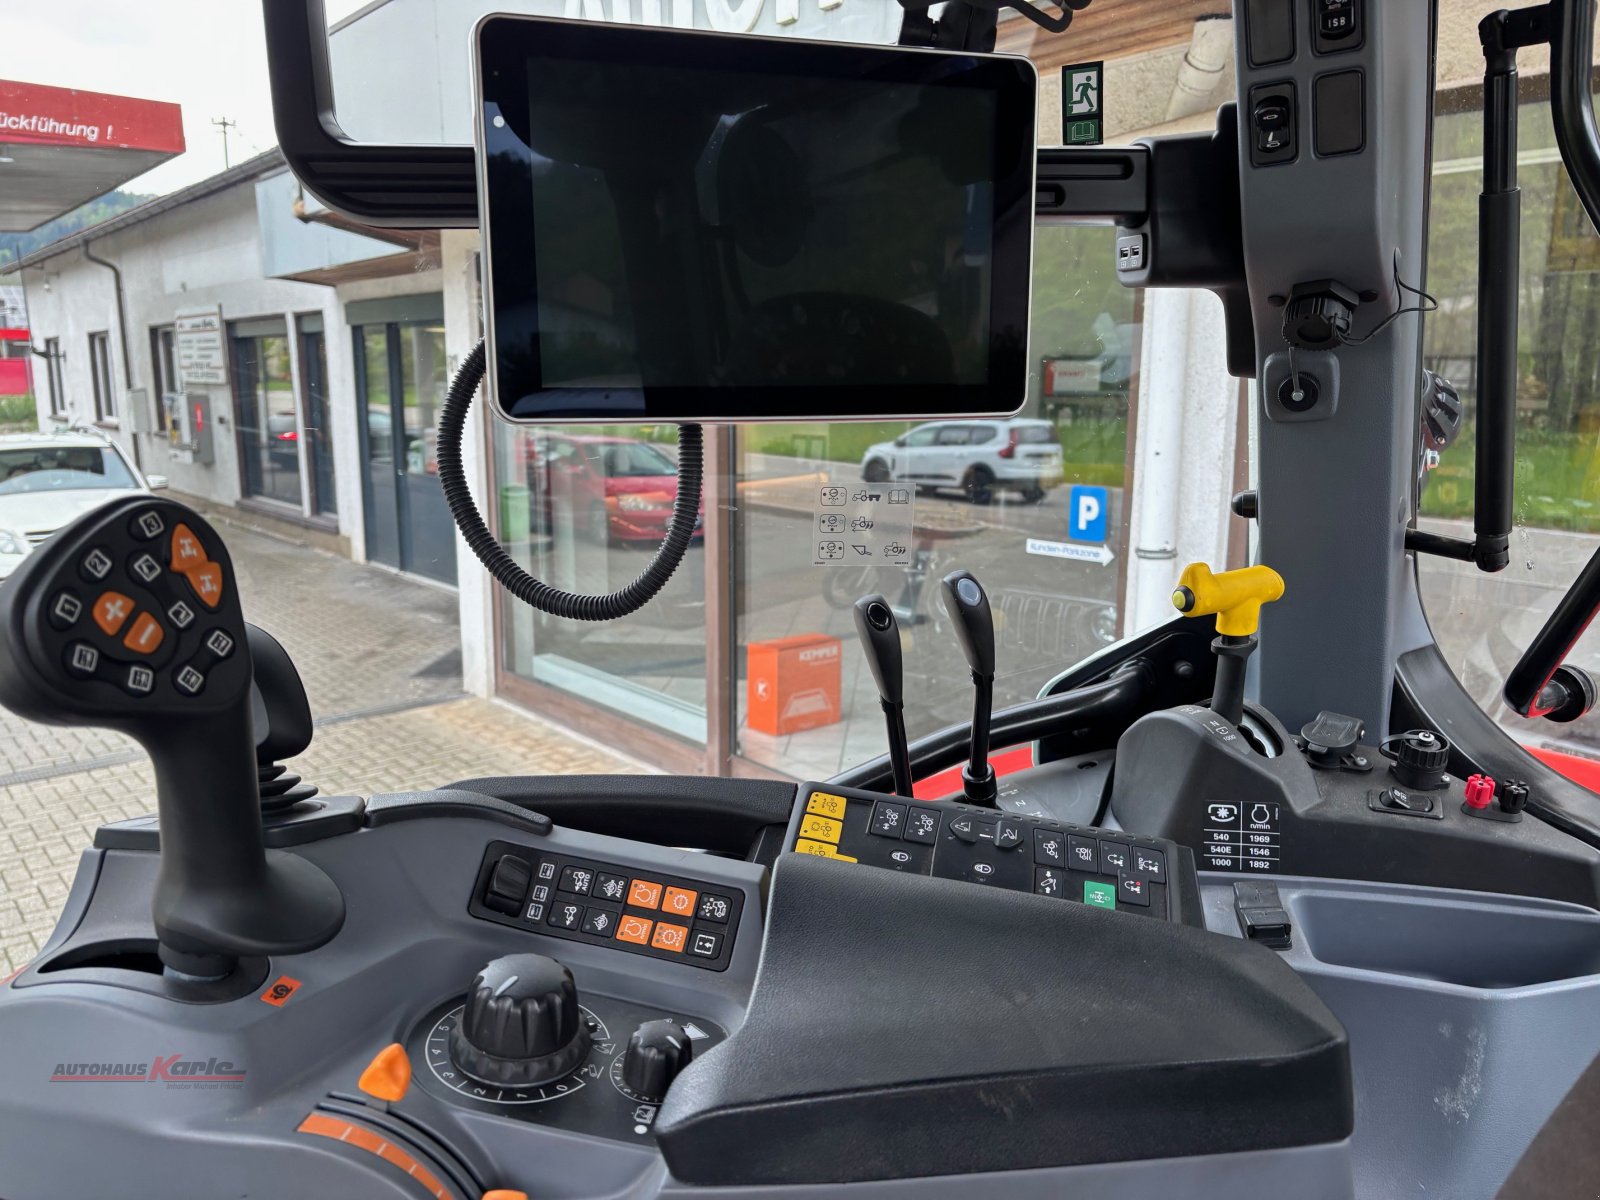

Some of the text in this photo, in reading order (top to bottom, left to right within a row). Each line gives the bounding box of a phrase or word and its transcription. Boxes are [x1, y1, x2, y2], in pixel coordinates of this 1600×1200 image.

[1078, 495, 1100, 530] P
[1213, 832, 1270, 843] 540 1969
[1210, 845, 1270, 856] 540E 1546
[1211, 858, 1270, 869] 1000 1892
[581, 873, 591, 892] AUTO
[615, 880, 625, 898] AUTO
[442, 1071, 455, 1079] 3
[473, 1087, 487, 1096] 2
[556, 1084, 568, 1092] 0
